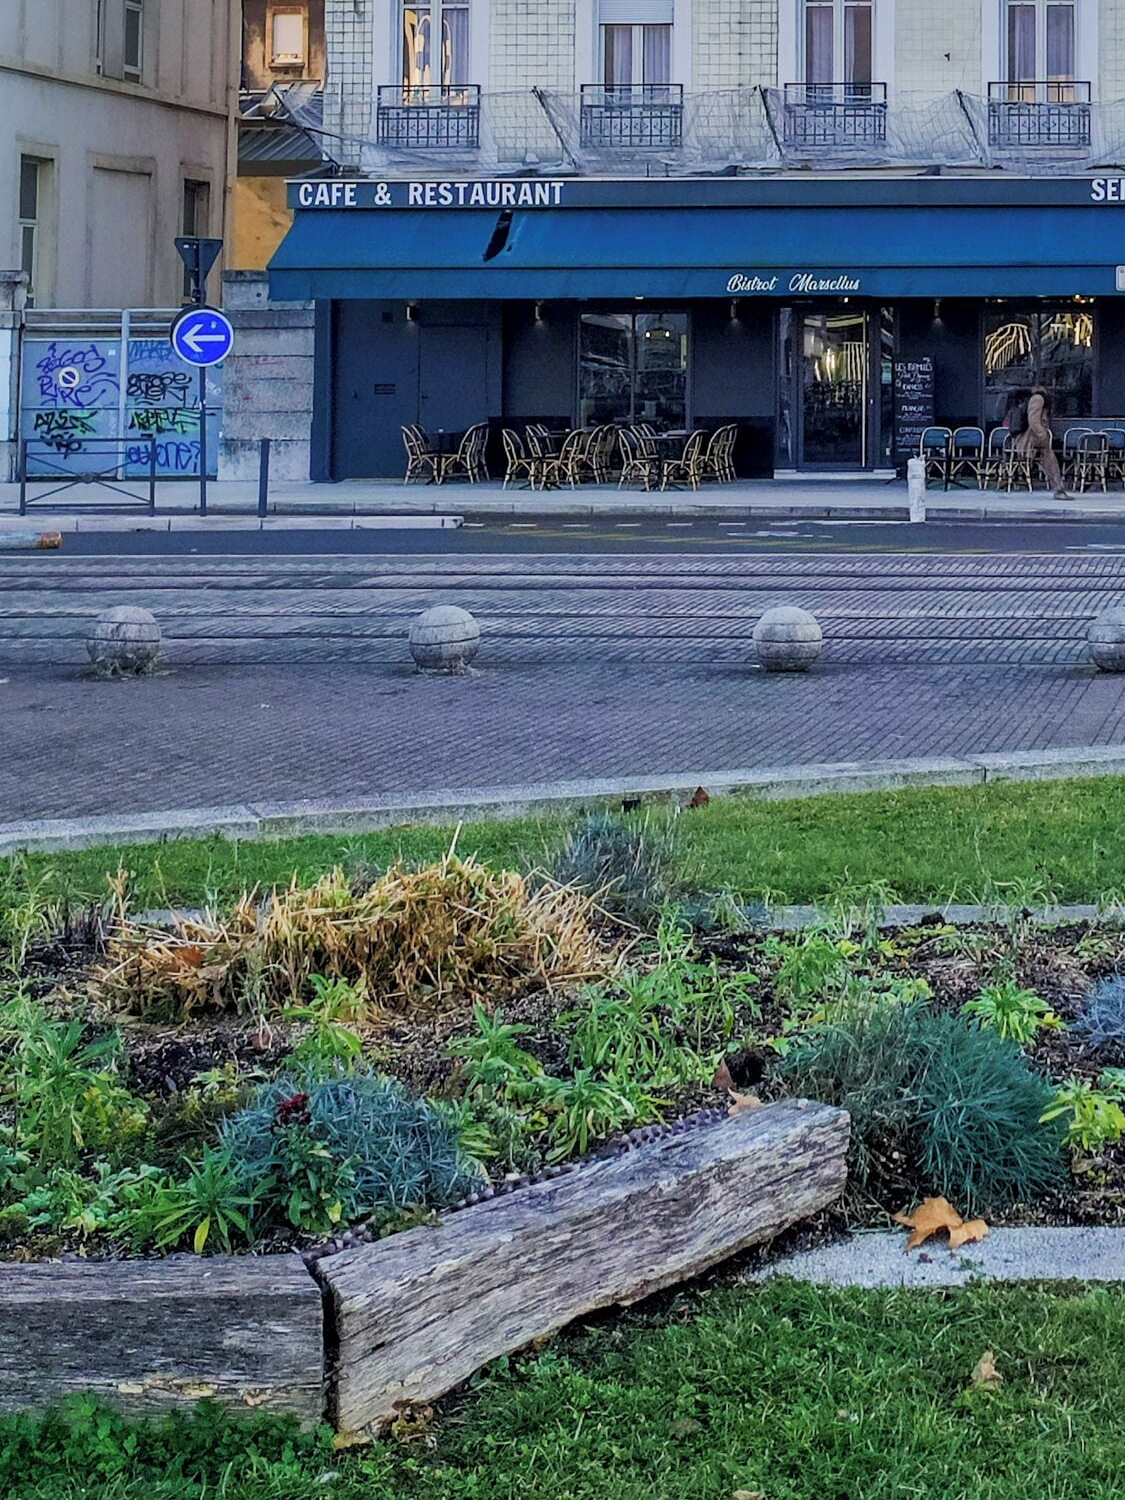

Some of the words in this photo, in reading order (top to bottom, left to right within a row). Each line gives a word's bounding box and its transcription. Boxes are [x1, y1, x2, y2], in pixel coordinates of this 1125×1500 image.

[299, 183, 358, 207] CAFE
[374, 182, 393, 206] &
[408, 181, 565, 206] RESTAURANT
[726, 273, 779, 293] Bistrot
[788, 273, 860, 293] Marsellus
